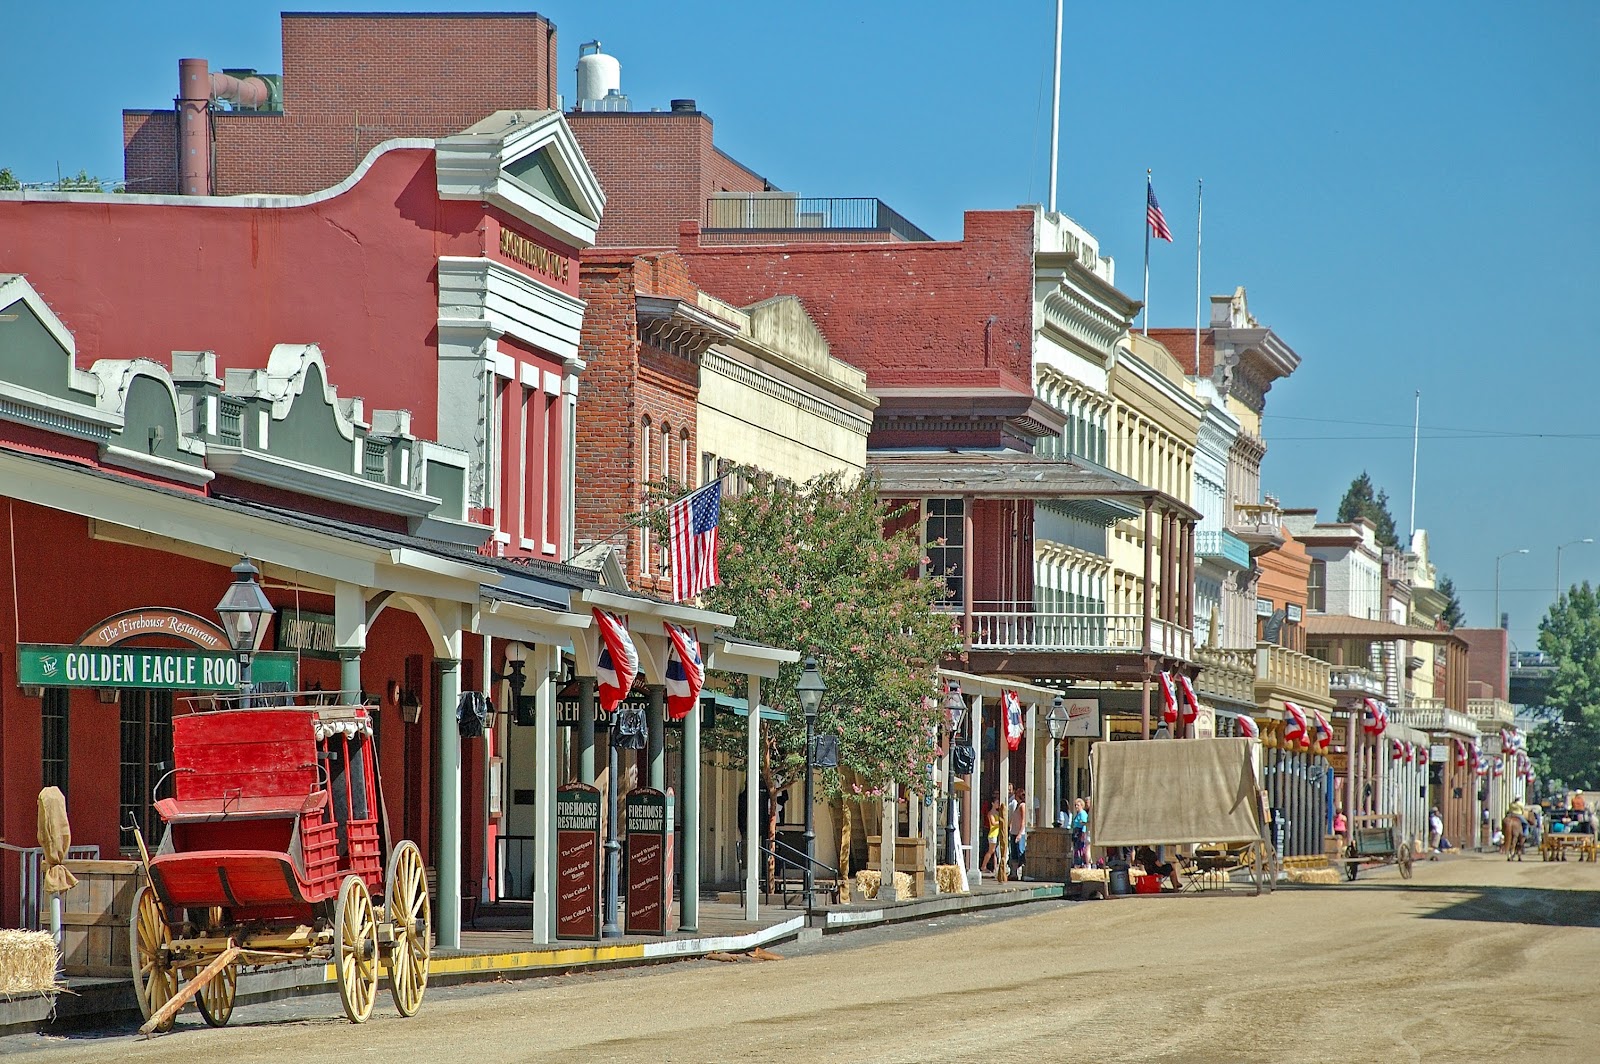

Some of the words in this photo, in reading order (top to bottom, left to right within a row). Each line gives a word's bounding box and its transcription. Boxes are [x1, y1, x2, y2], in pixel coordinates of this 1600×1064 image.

[99, 626, 119, 643] The
[119, 615, 165, 634] Firehouse
[167, 616, 219, 646] Restaurant
[66, 653, 134, 682] GOLDEN
[142, 655, 196, 684] EAGLE
[203, 657, 241, 686] ROO
[557, 802, 597, 816] FIREHOUSE
[628, 805, 663, 819] FIREHOUSE
[557, 816, 597, 829] RESTAURANT
[628, 818, 663, 831] RESTAURANT
[561, 849, 570, 857] The
[570, 840, 593, 854] Courtyard
[562, 867, 578, 877] Golden
[578, 861, 590, 870] Eagle
